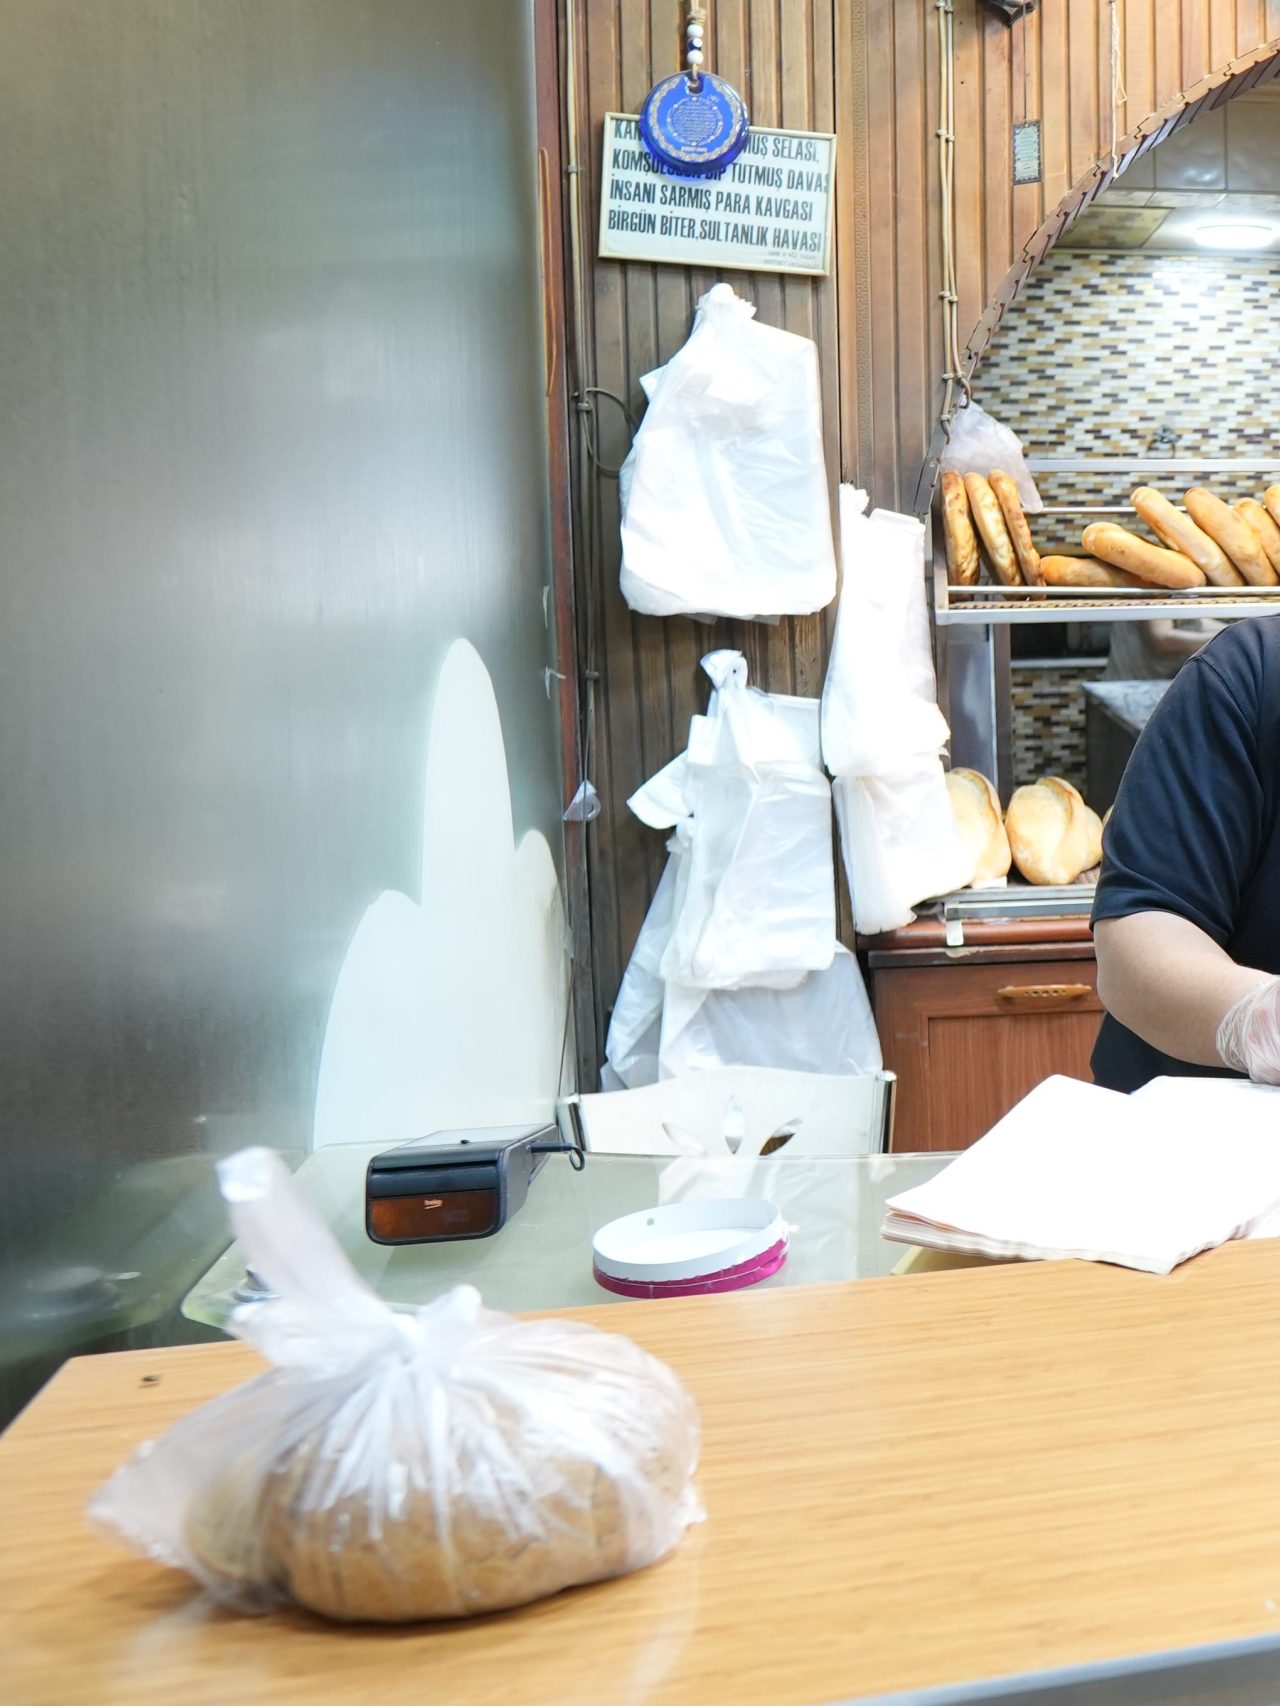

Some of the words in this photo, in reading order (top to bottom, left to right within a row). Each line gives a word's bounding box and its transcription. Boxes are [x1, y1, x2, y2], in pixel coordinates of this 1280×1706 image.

[610, 173, 656, 204] İNSANI
[660, 184, 711, 213] SARMIŞ
[715, 191, 751, 215] PARA
[755, 196, 813, 222] KAVGASI
[731, 163, 783, 191] TUTMUŞ
[608, 205, 656, 234] BİRGÜN
[772, 227, 822, 252] HAVASI
